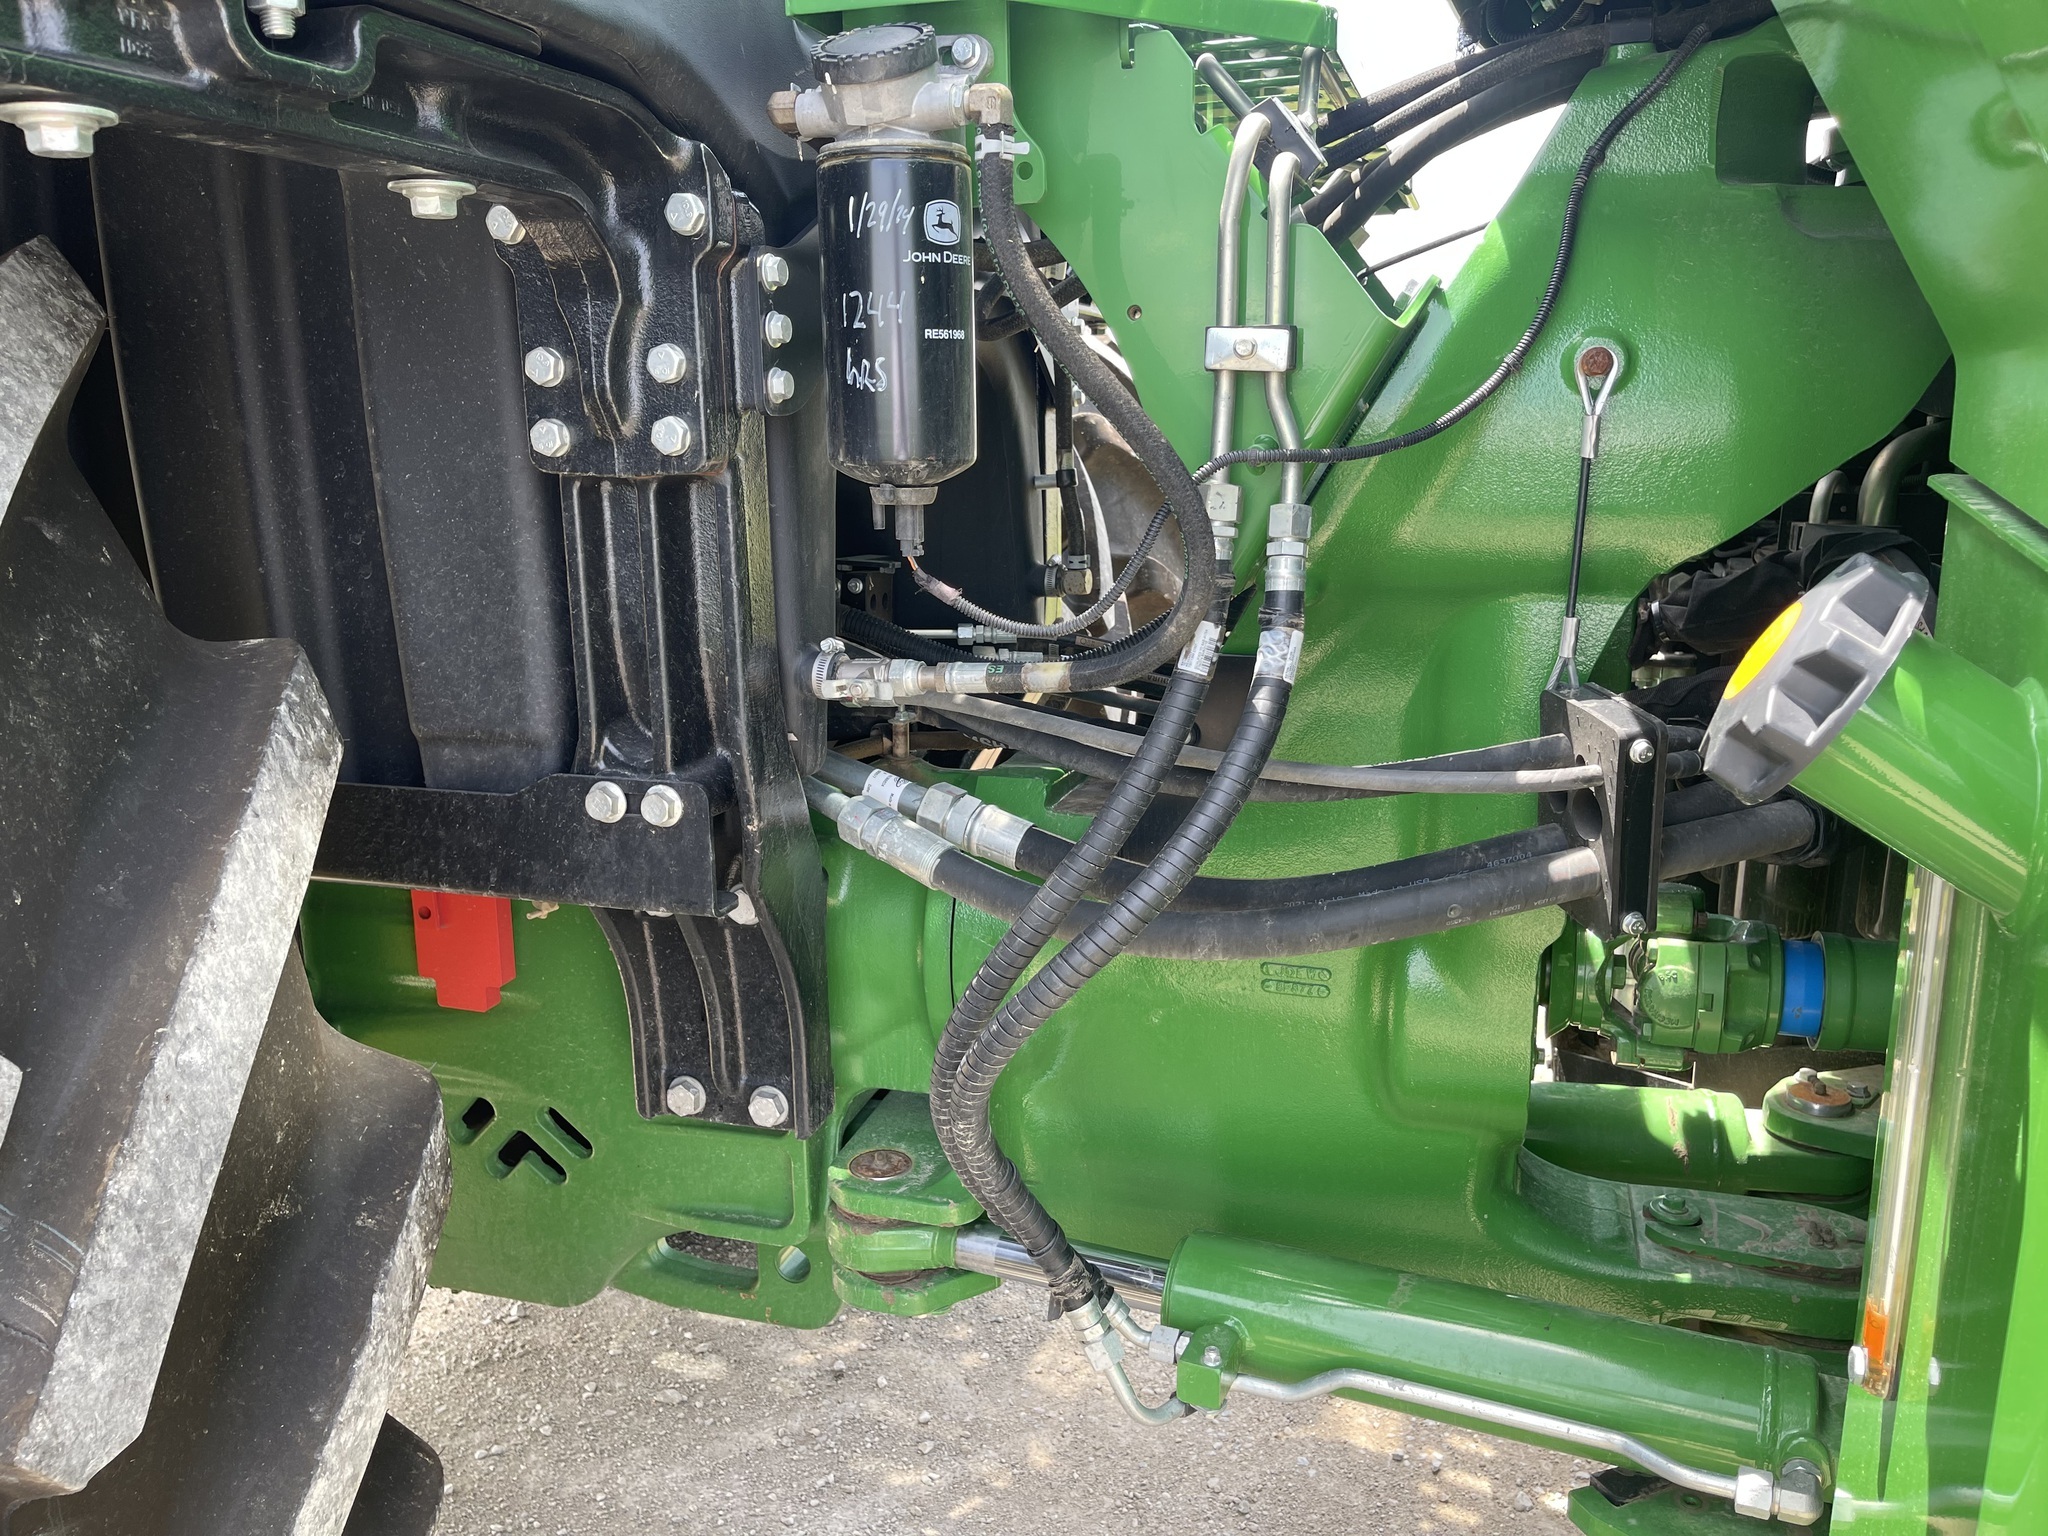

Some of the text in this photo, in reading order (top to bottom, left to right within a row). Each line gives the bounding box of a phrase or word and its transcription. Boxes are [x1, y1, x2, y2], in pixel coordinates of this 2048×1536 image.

[902, 249, 972, 266] JOHN DEERE
[842, 290, 906, 329] 1244
[924, 328, 966, 341] RE561968
